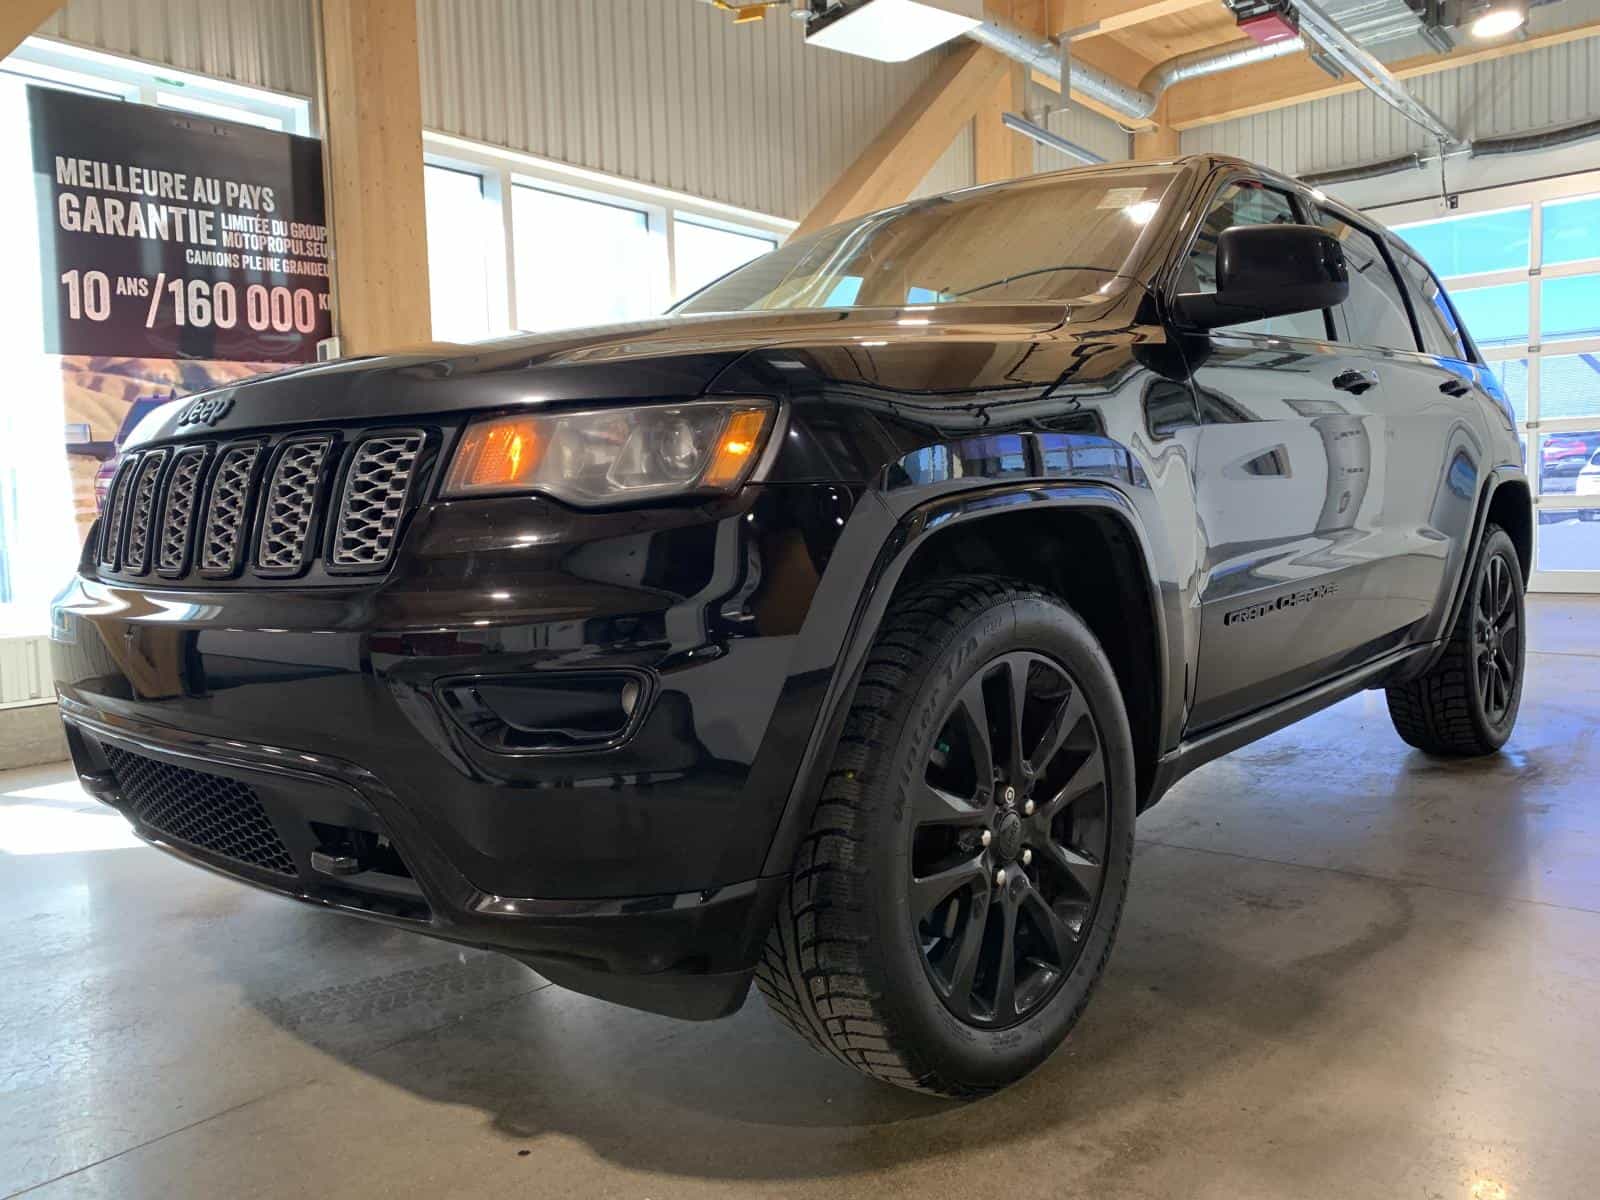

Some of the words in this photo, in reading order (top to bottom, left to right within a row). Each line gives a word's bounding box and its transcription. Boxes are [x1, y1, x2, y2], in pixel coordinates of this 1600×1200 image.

[55, 156, 188, 201] MEILLEURE
[192, 177, 221, 207] AU
[225, 182, 276, 213] PAYS
[58, 192, 217, 247] GARANTIE
[221, 212, 270, 235] LIMITÉE
[271, 219, 289, 238] DU
[290, 222, 328, 242] GROUP
[222, 230, 328, 259] MOTOPROPULSEU
[185, 249, 240, 269] CAMIONS
[241, 255, 281, 273] PLEINE
[61, 269, 112, 322] 10
[115, 276, 149, 298] ANS
[318, 293, 329, 311] K
[177, 399, 236, 427] Jeep
